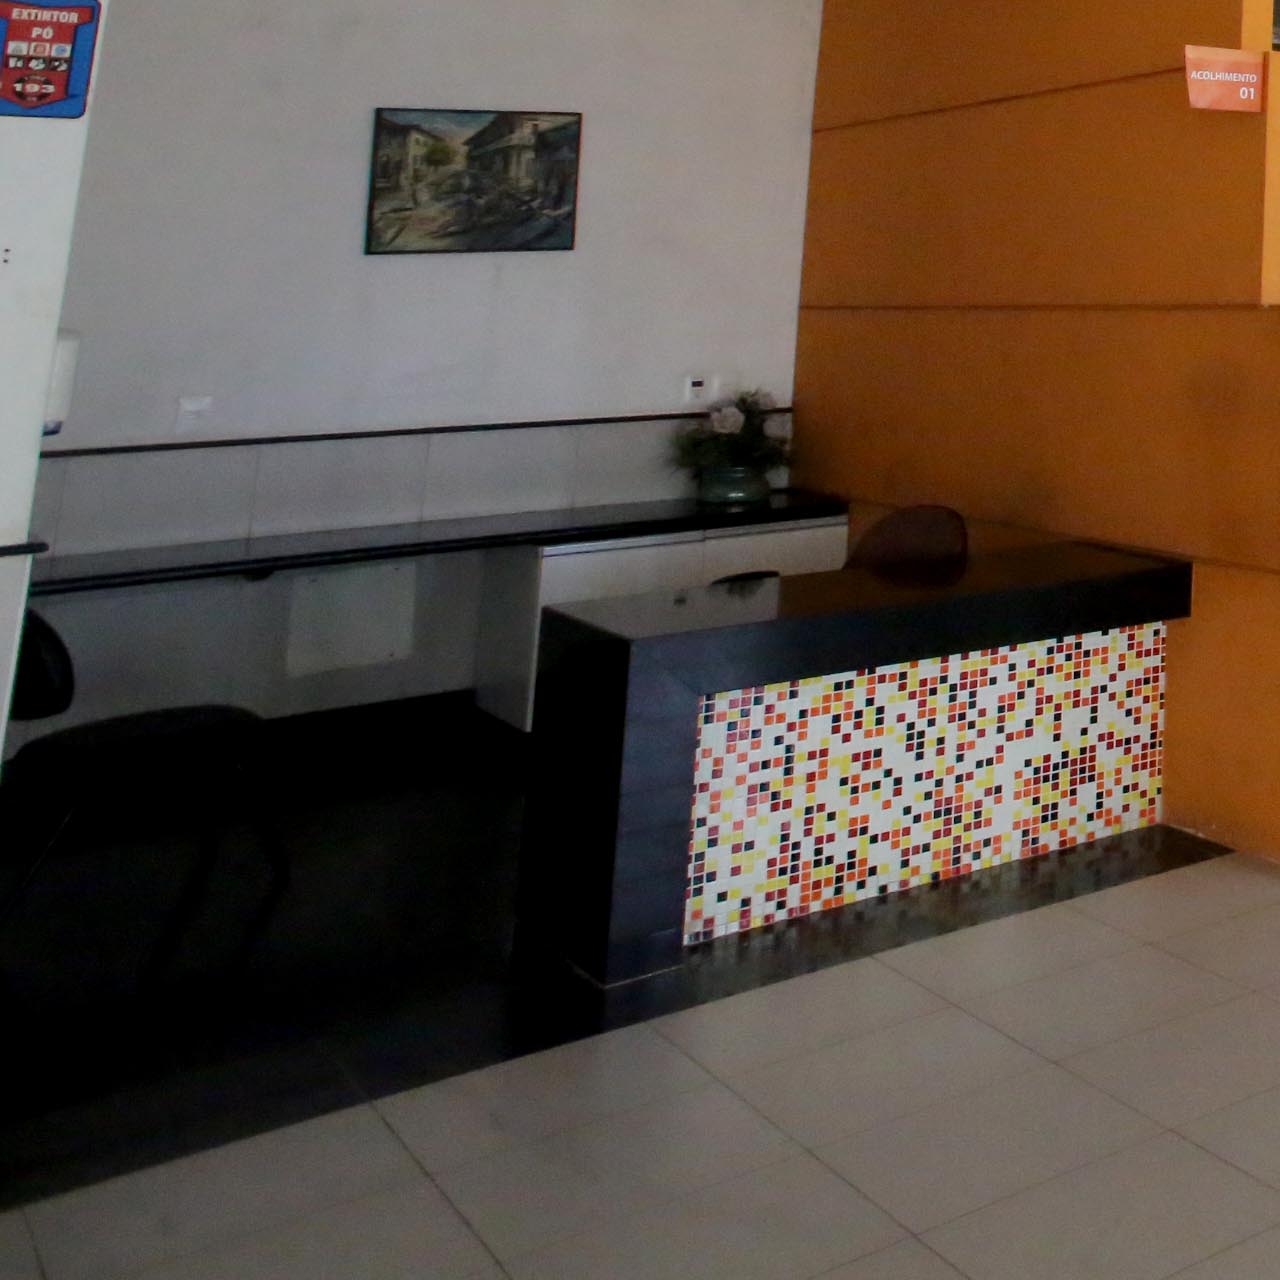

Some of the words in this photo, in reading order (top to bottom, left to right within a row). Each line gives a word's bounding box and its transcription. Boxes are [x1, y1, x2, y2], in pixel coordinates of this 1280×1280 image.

[12, 8, 79, 23] EXTINTOR
[32, 26, 54, 39] PÓ
[1191, 71, 1257, 83] ACOLHIMENTO
[14, 83, 55, 93] 193
[1239, 86, 1256, 100] 01
